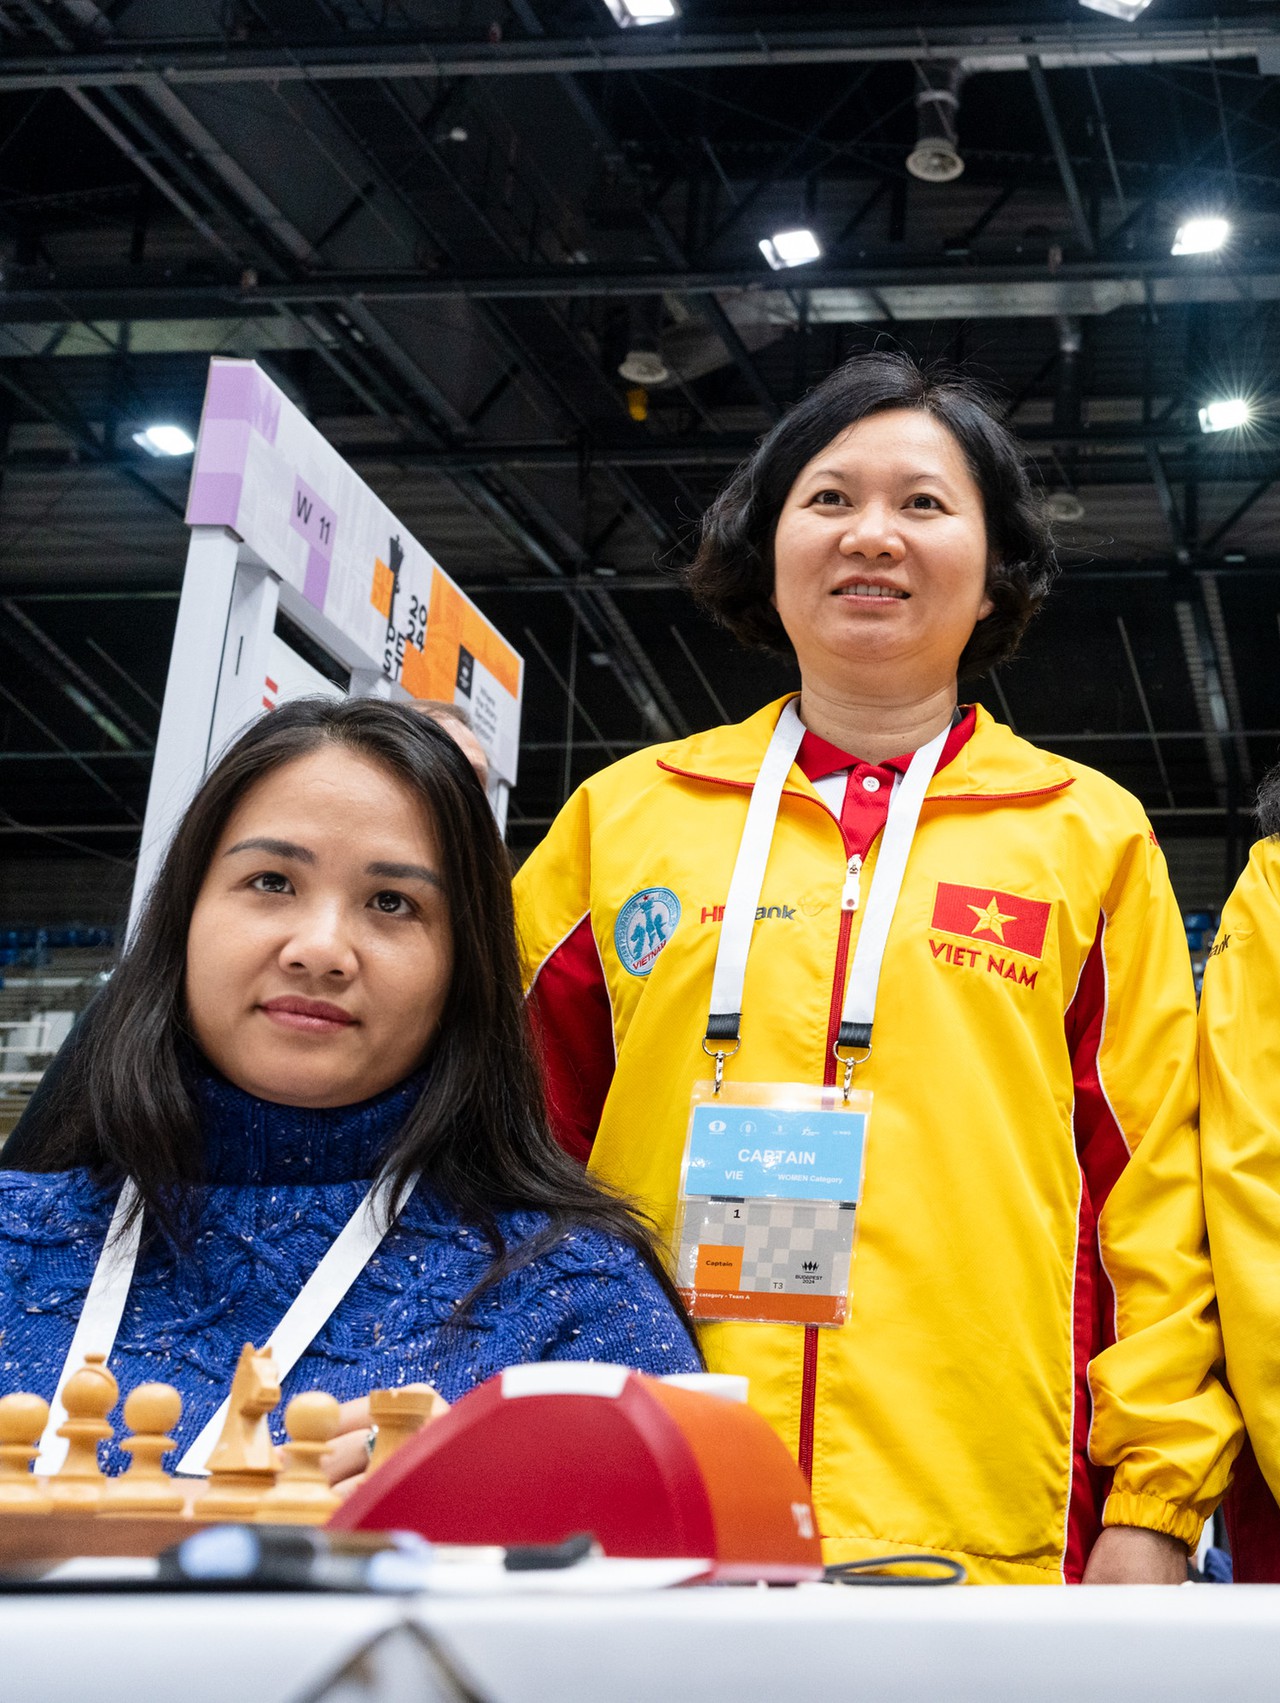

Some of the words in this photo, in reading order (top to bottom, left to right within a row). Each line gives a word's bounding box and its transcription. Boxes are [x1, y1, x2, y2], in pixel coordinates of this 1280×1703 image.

[297, 490, 313, 525] W
[319, 516, 331, 545] 11
[928, 938, 982, 968] VIET
[987, 954, 1039, 990] NAM
[737, 1148, 817, 1166] CAPTAIN
[724, 1170, 744, 1181] VIE
[777, 1173, 809, 1182] WOMEN
[810, 1174, 844, 1184] Category
[733, 1209, 741, 1218] 1
[705, 1259, 733, 1268] Captain
[773, 1281, 784, 1290] T3
